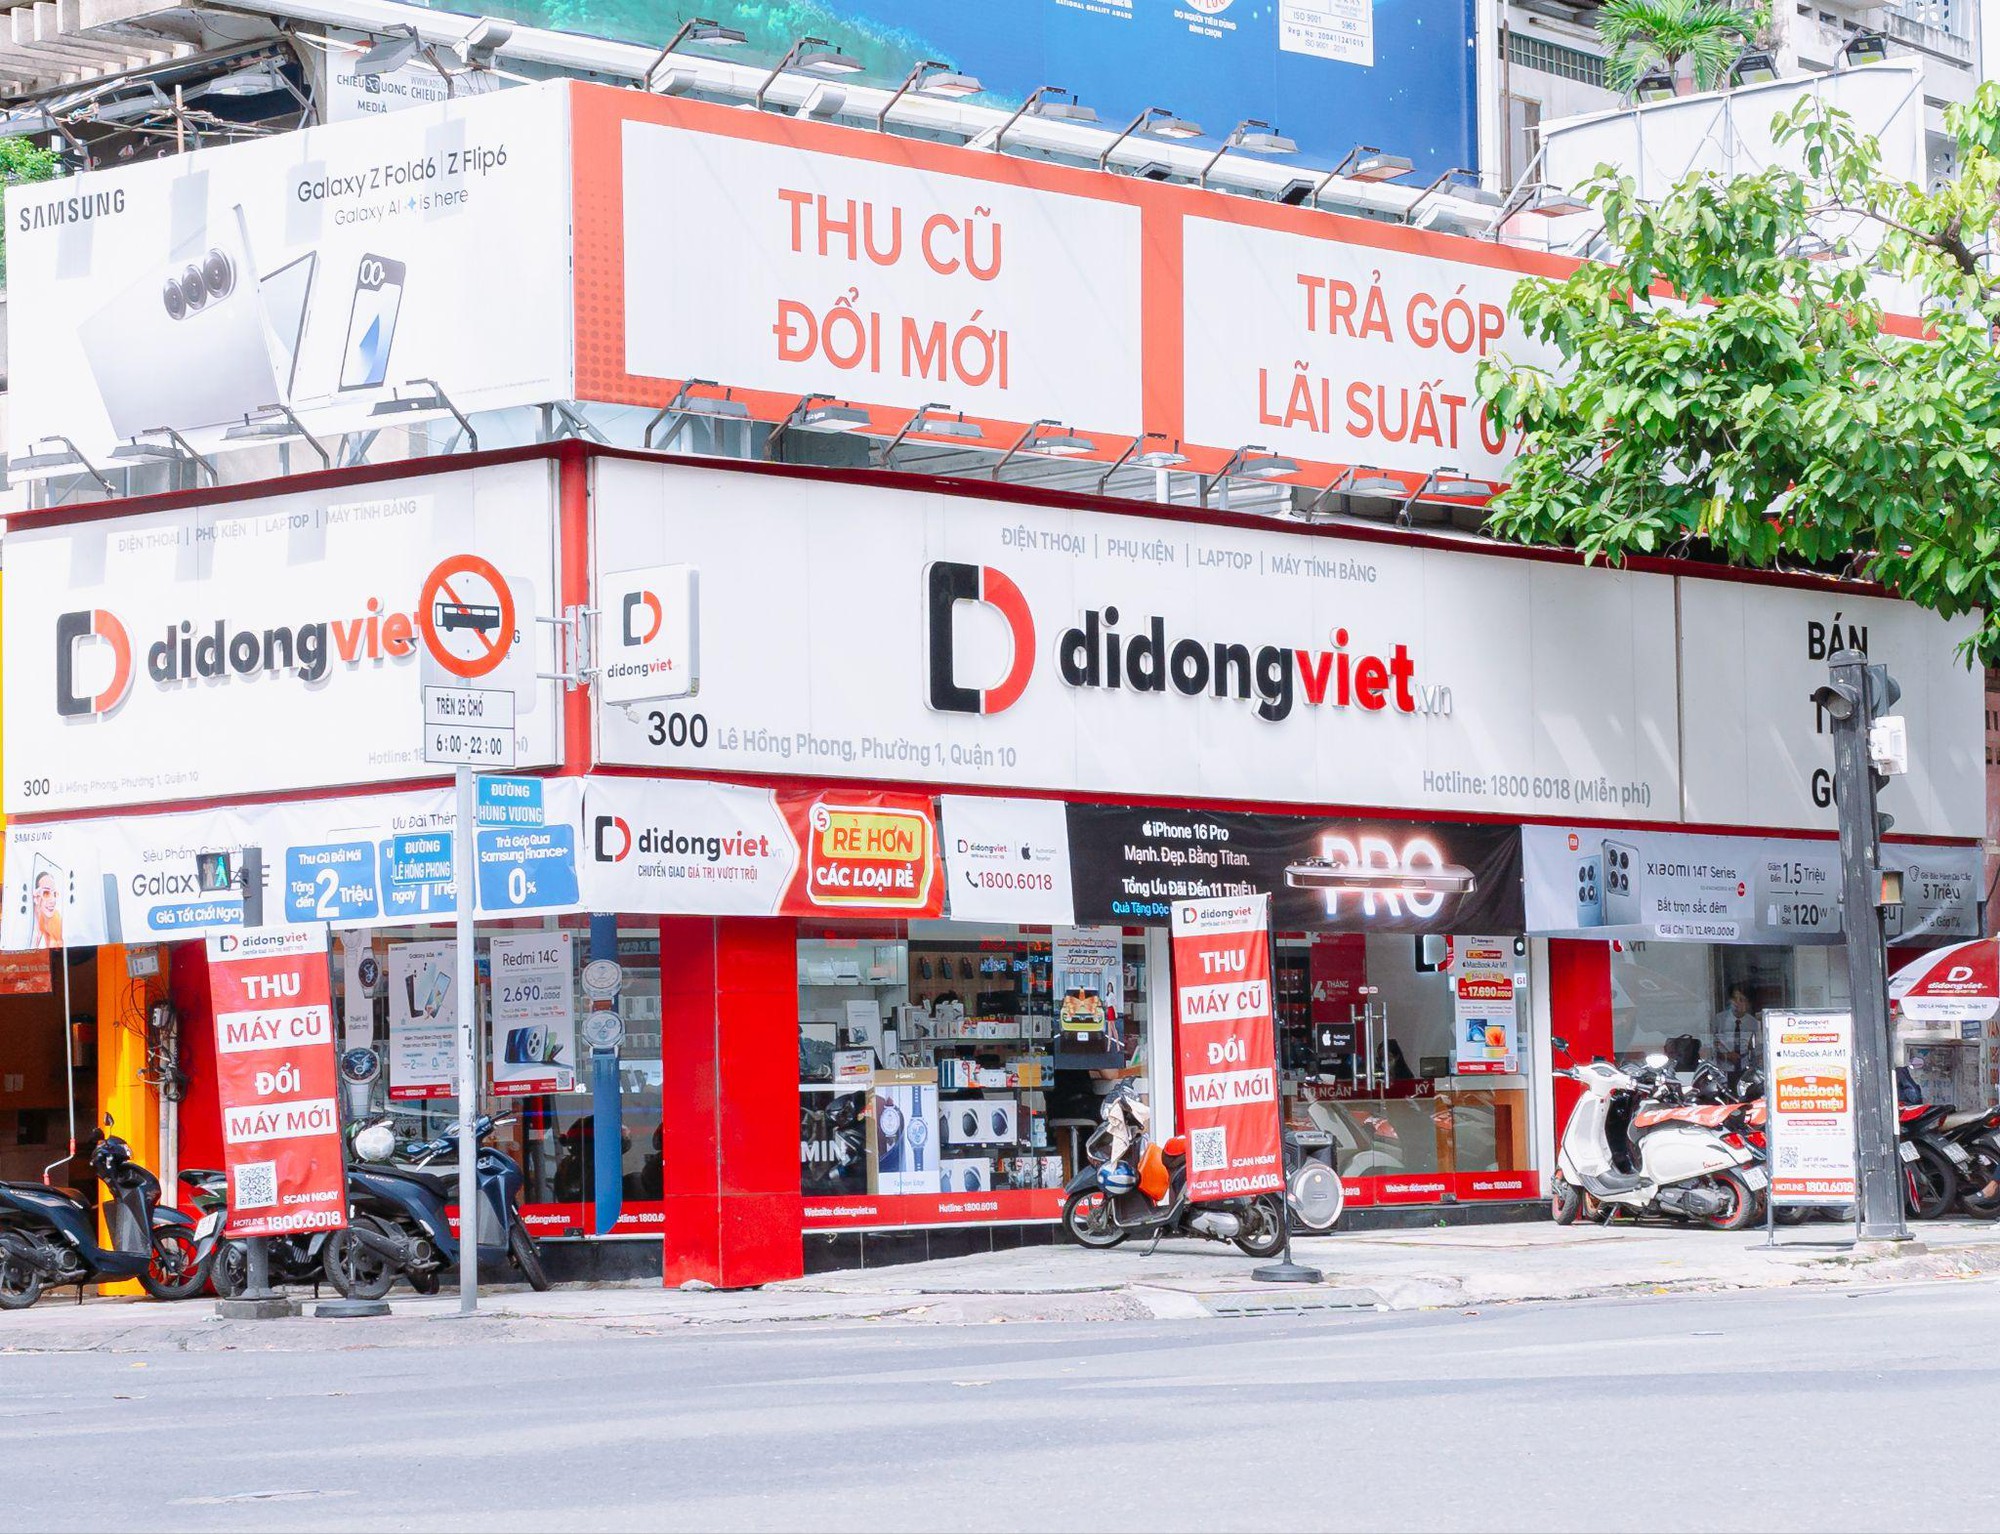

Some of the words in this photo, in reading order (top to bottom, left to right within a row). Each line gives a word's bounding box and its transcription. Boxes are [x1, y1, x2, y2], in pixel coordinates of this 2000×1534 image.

[357, 100, 387, 114] MEDIA
[297, 173, 366, 202] Galaxy
[370, 167, 380, 190] Z
[385, 157, 436, 187] Fold6
[448, 152, 458, 175] Z
[463, 144, 507, 176] Flip6
[20, 188, 125, 232] SAMSUNG
[335, 204, 384, 226] Galaxy
[419, 194, 430, 211] is
[434, 188, 469, 208] here
[778, 188, 901, 266] THU
[922, 205, 1001, 281] CŨ
[1297, 269, 1393, 343] TRẢ
[1406, 284, 1505, 356] GÓP
[772, 286, 880, 373] ĐỔI
[902, 309, 1008, 390] MỚI
[1259, 360, 1329, 434] LÃI
[1346, 379, 1467, 450] SUẤT
[265, 515, 309, 533] LAPTOP
[1001, 525, 1037, 552] ĐIỆN
[1041, 532, 1086, 559] THOẠI
[1107, 538, 1138, 563] PHỤ
[1142, 539, 1174, 567] KIỆN
[1198, 548, 1253, 570] LAPTOP
[1272, 551, 1300, 576] MÁY
[1304, 554, 1336, 579] TÍNH
[1808, 612, 1868, 661] BÁN
[458, 698, 467, 716] 25
[647, 711, 708, 748] 300
[717, 729, 738, 751] Lê
[743, 729, 792, 760] Hồng
[796, 733, 857, 761] Phong,
[861, 735, 931, 767] Phường
[950, 744, 993, 771] Quận
[998, 746, 1017, 768] 10
[368, 749, 411, 767] Hotline:
[23, 778, 50, 798] 300
[491, 782, 530, 798] ĐƯỜNG
[1423, 770, 1487, 796] Hotline:
[1490, 775, 1529, 798] 1800
[1533, 777, 1570, 800] 6018
[1574, 776, 1617, 805] (Miễn
[1621, 781, 1651, 808] phí)
[479, 800, 507, 822] HÙNG
[508, 805, 542, 822] VƯƠNG
[530, 834, 550, 846] Qua
[832, 819, 861, 852] RẺ
[867, 825, 914, 854] HƠN
[1152, 821, 1192, 839] iPhone
[1193, 825, 1208, 841] 16
[1210, 827, 1230, 842] Pro
[405, 841, 440, 855] ĐƯỜNG
[481, 848, 524, 864] Samsung
[1124, 845, 1160, 866] Mạnh.
[1160, 847, 1187, 868] Đẹp.
[1188, 842, 1218, 868] Bằng
[1220, 850, 1251, 868] Titan.
[299, 853, 316, 865] Thu
[404, 858, 424, 880] HỒNG
[425, 861, 450, 879] PHONG
[668, 865, 686, 879] GIAO
[687, 865, 701, 879] GIÁ
[816, 867, 851, 888] CÁC
[853, 868, 892, 896] LOẠI
[895, 862, 915, 888] RẺ
[978, 871, 1053, 891] 1800.6018
[1322, 836, 1446, 919] PRO
[1693, 866, 1707, 879] 14T
[1710, 866, 1737, 880] Series
[1782, 862, 1802, 885] 1.5
[1803, 866, 1827, 883] Triệu
[316, 868, 340, 919] 2
[339, 885, 374, 907] Triệu
[1122, 876, 1150, 898] Tổng
[1151, 879, 1167, 895] Ưu
[1168, 880, 1188, 898] Đãi
[1188, 879, 1211, 898] Đến
[1211, 882, 1222, 897] 11
[1923, 883, 1930, 900] 3
[1933, 883, 1960, 904] Triệu
[155, 908, 175, 924] Giá
[176, 905, 193, 923] Tốt
[194, 904, 216, 922] Chốt
[1112, 900, 1131, 915] Quà
[1131, 901, 1151, 917] Tặng
[1152, 900, 1171, 916] Độc
[1200, 905, 1252, 920] didongviet
[1657, 899, 1672, 913] Bắt
[1673, 900, 1691, 916] trọn
[1696, 898, 1709, 915] sắc
[1710, 900, 1727, 915] đêm
[1659, 923, 1671, 935] Giá
[242, 932, 309, 948] didongviet
[502, 952, 535, 967] Redmi
[538, 949, 560, 965] 14C
[1199, 948, 1246, 975] THU
[241, 972, 301, 1001] THU
[1187, 991, 1230, 1016] MÁY
[1237, 985, 1262, 1010] CŨ
[226, 1015, 282, 1045] MÁY
[290, 1010, 322, 1038] CŨ
[1207, 1034, 1247, 1065] ĐỔI
[1783, 1049, 1819, 1058] MacBook
[1822, 1049, 1833, 1058] Air
[255, 1062, 301, 1096] ĐỔI
[1189, 1078, 1228, 1103] MÁY
[1233, 1072, 1269, 1098] MỚI
[1780, 1085, 1844, 1097] MacBook
[1802, 1100, 1814, 1110] 20
[1816, 1097, 1844, 1111] TRIỆU
[231, 1111, 280, 1137] MÁY
[287, 1105, 332, 1131] MỚI
[1232, 1157, 1254, 1169] SCAN
[1254, 1154, 1276, 1167] NGAY
[1220, 1174, 1279, 1192] 1800.6018
[1806, 1181, 1854, 1194] 1800.6018
[283, 1193, 308, 1205] SCAN
[308, 1190, 339, 1204] NGAY
[233, 1217, 264, 1229] HOTLINE
[266, 1210, 342, 1231] 1800.6018
